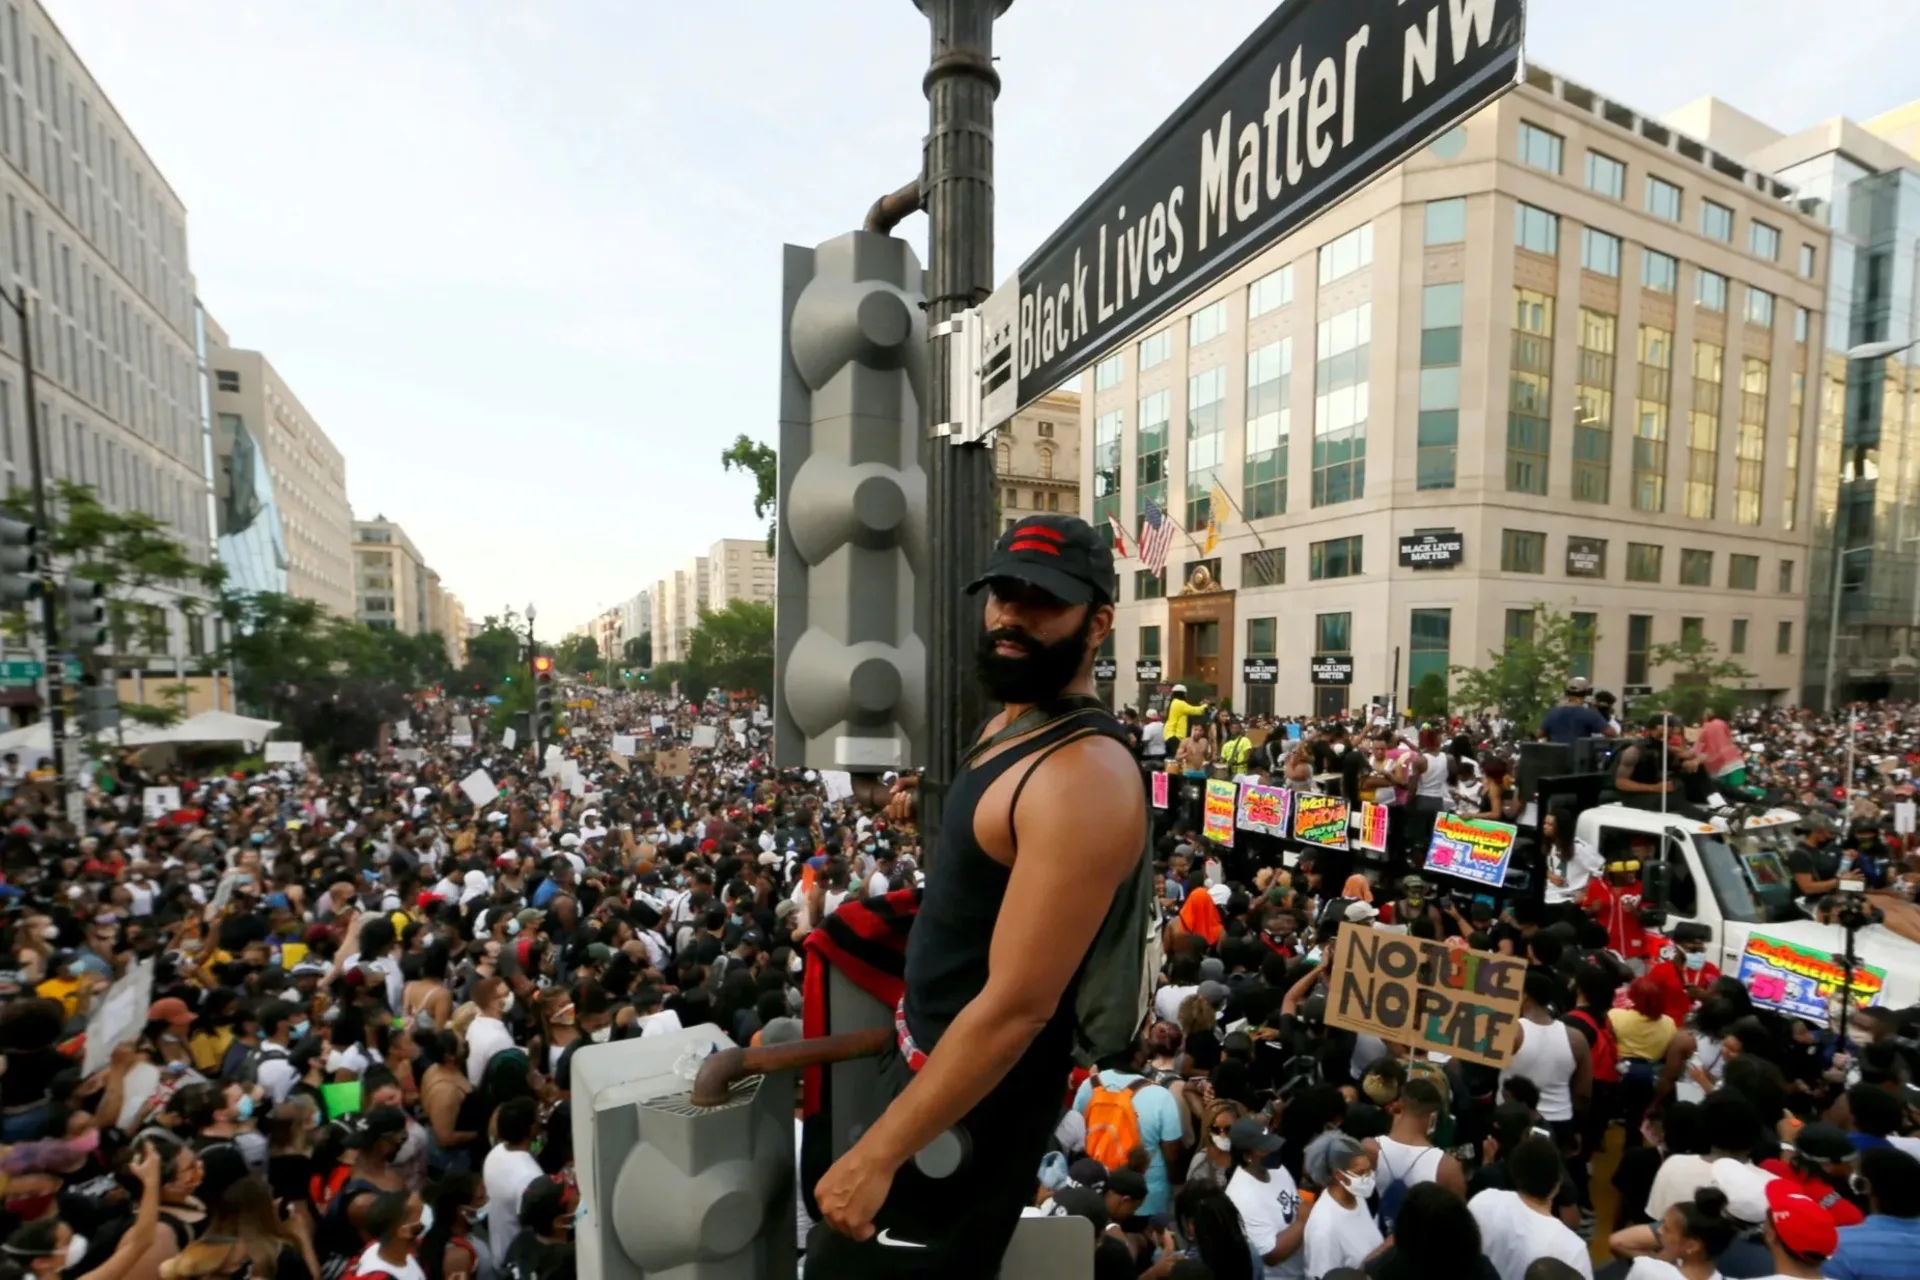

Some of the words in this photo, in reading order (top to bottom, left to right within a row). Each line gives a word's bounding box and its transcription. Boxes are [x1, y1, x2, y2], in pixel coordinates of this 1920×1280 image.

[1020, 247, 1088, 381] Black
[1098, 186, 1184, 324] Lives
[1198, 24, 1370, 252] Matter
[1402, 0, 1496, 104] NW
[1401, 544, 1431, 554] BLACK
[1433, 542, 1460, 552] LIVES
[1411, 551, 1450, 561] MATTER
[1313, 664, 1332, 672] BLACK
[1333, 664, 1352, 672] LIVES
[1318, 671, 1345, 679] MATTER
[1346, 930, 1417, 979] NO
[1416, 942, 1525, 1001] JUSTICE
[1339, 971, 1410, 1029] NO
[1412, 988, 1514, 1060] PEACE
